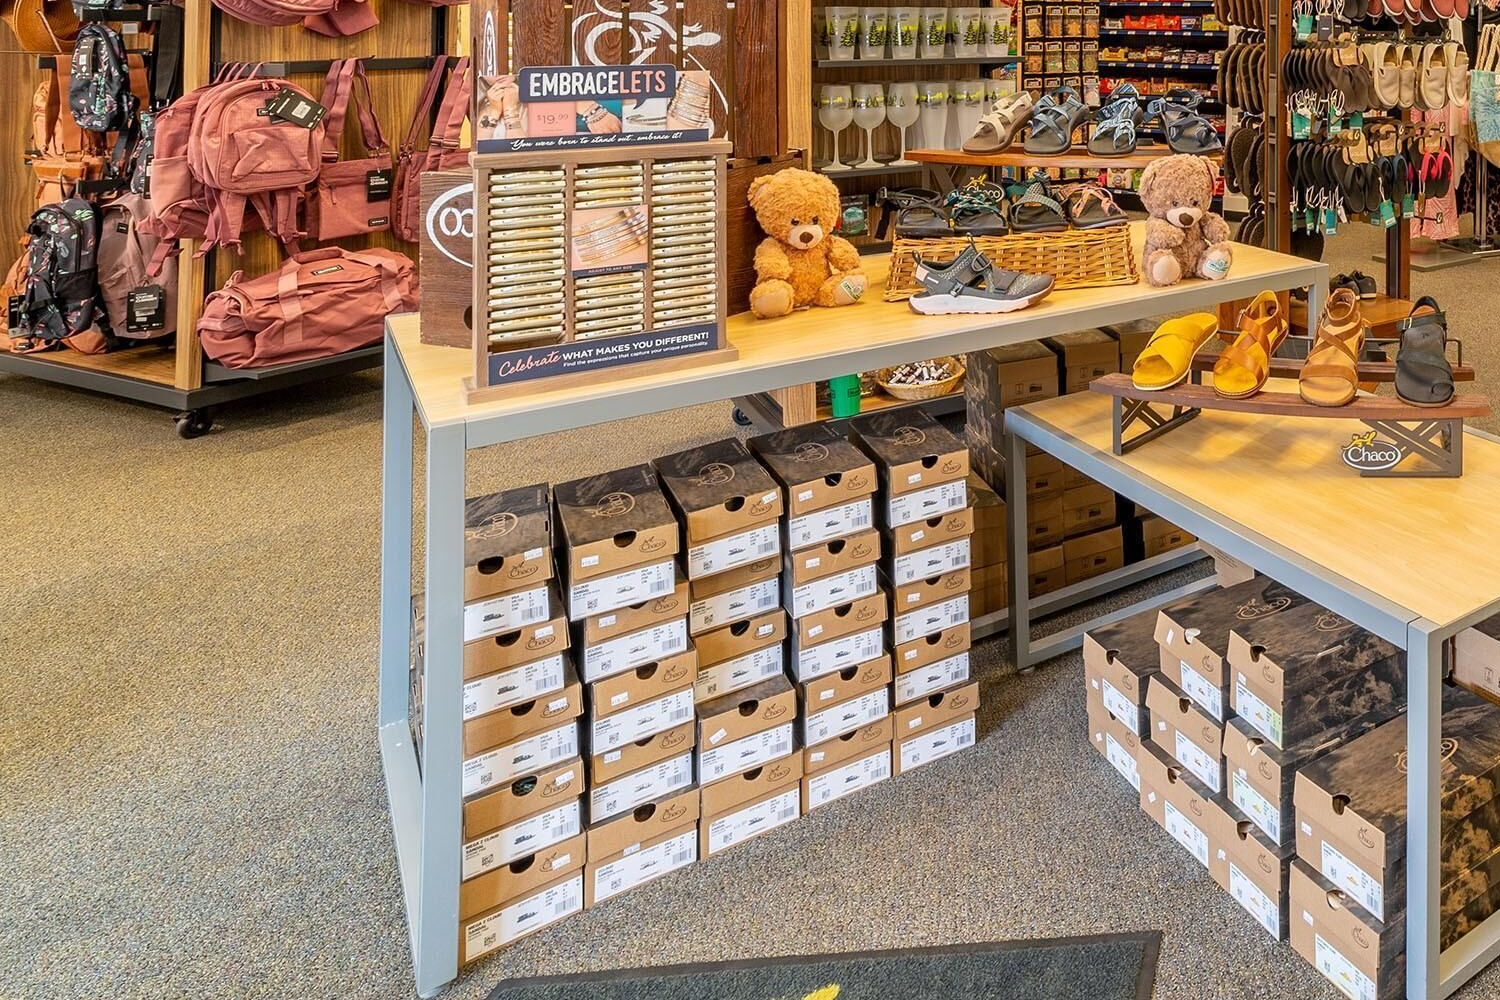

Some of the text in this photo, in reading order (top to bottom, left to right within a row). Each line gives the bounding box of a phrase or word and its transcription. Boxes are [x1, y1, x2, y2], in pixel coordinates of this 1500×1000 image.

[529, 70, 666, 97] EMBRACELETS
[499, 331, 710, 378] Celebrate WHAT MAKES YOU DIFFERENT!
[1348, 445, 1396, 462] Chaco
[510, 563, 538, 578] Chaco
